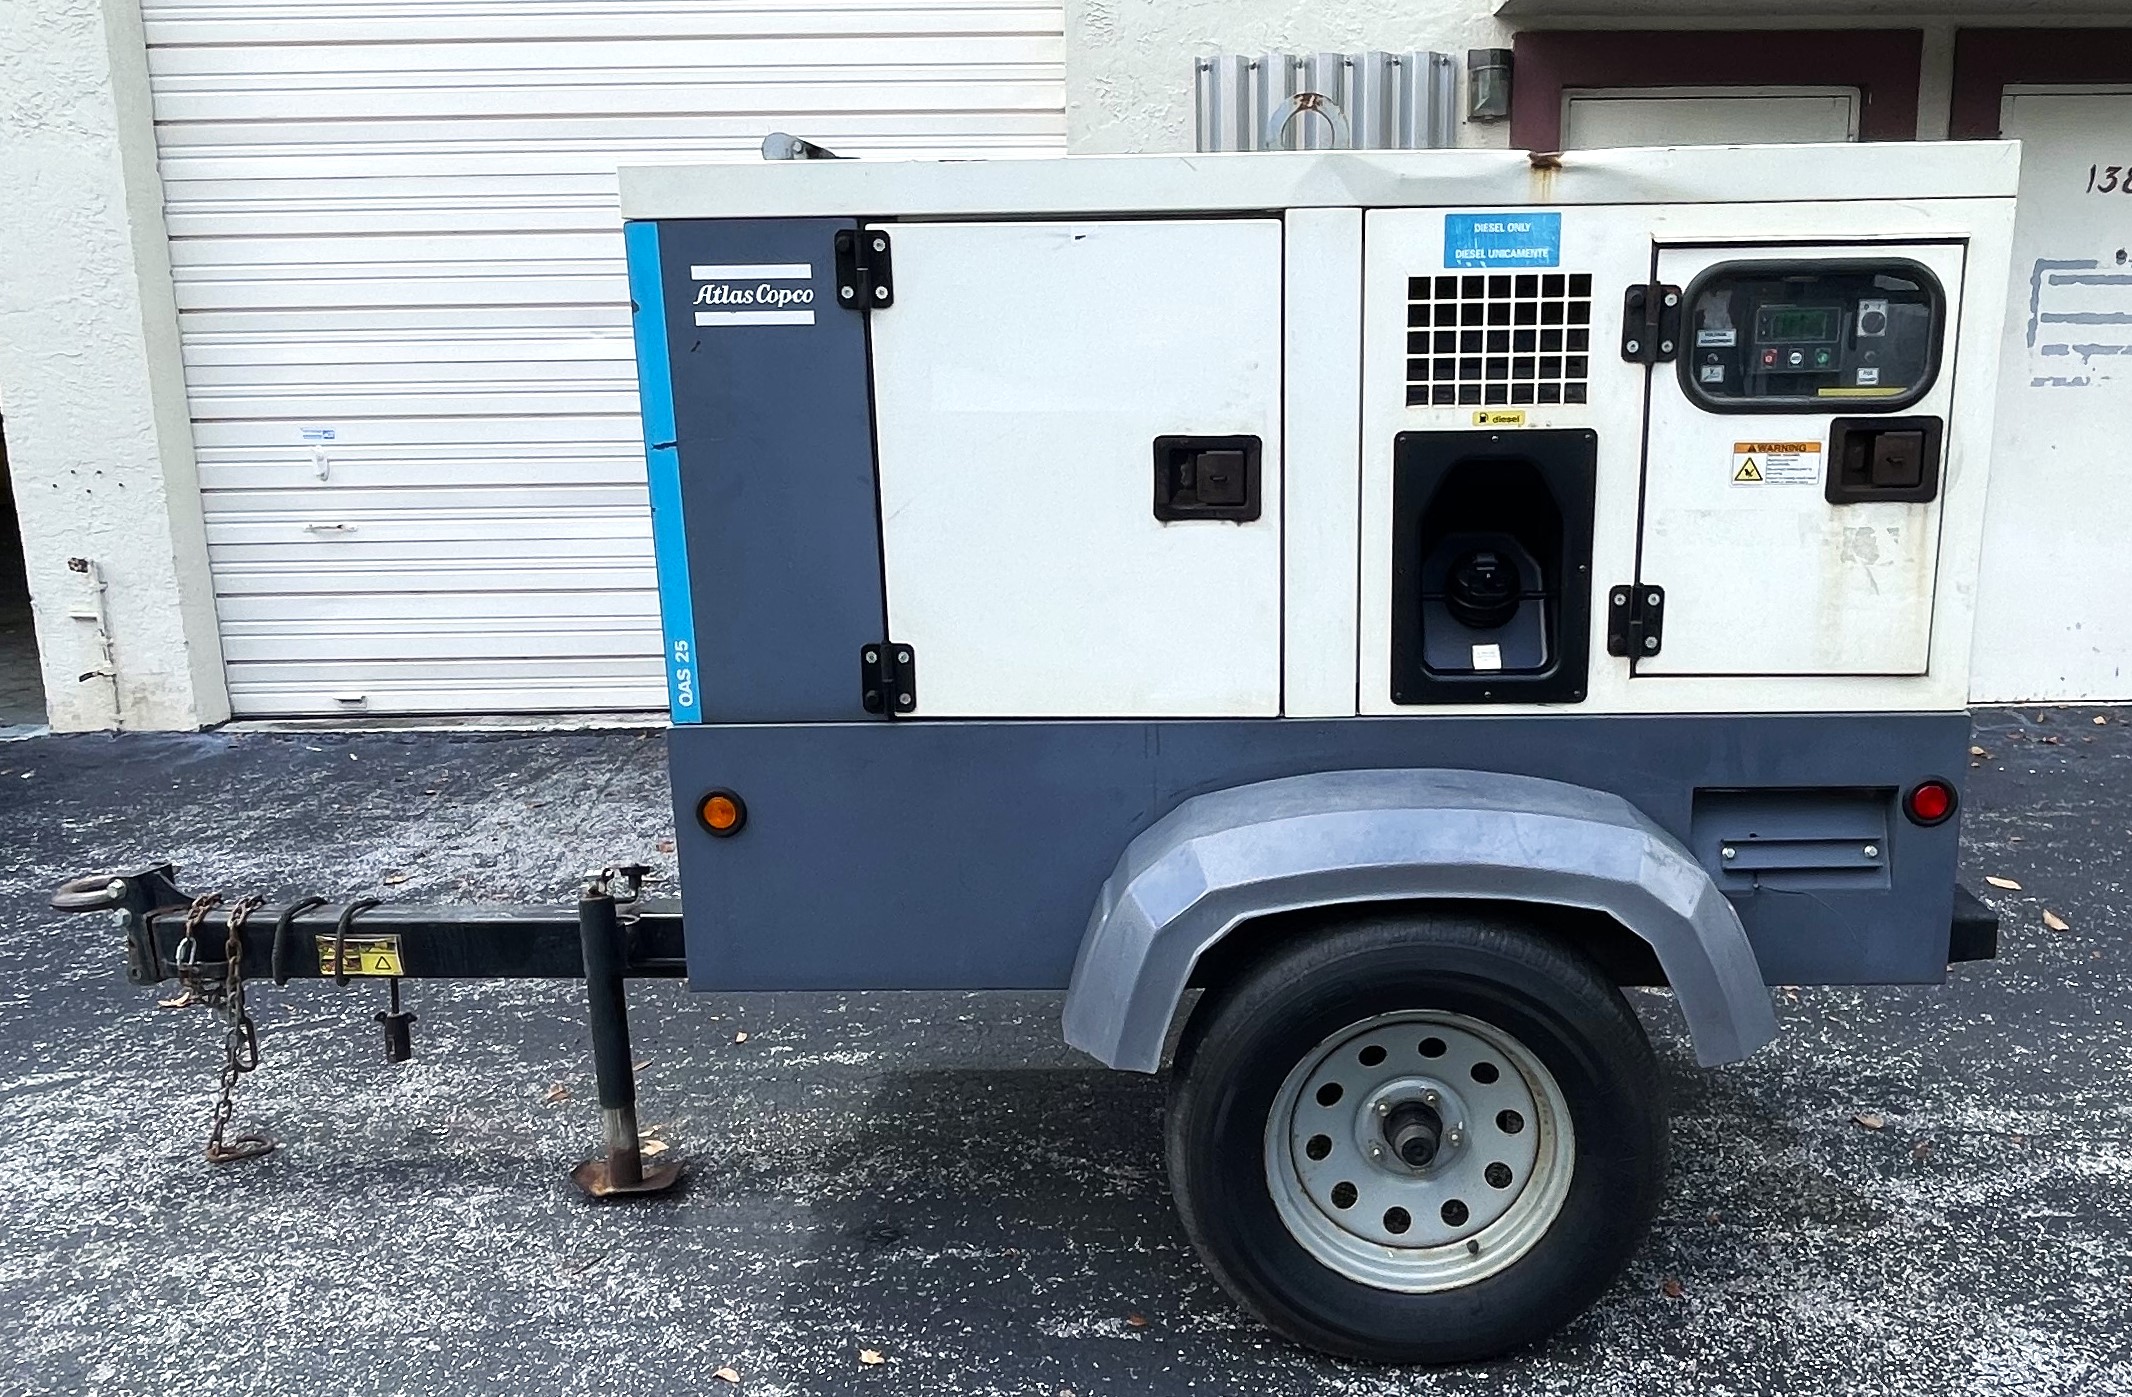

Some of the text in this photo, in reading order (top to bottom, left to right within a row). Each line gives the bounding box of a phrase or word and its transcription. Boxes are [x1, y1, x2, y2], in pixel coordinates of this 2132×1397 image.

[1475, 223, 1531, 232] DIESEL ONLY
[1455, 248, 1549, 259] DIESEL UNICAMENTE
[693, 284, 814, 308] Atlas Copco
[1493, 415, 1520, 423] diesel
[1757, 443, 1807, 453] WARNING
[675, 640, 689, 662] 25
